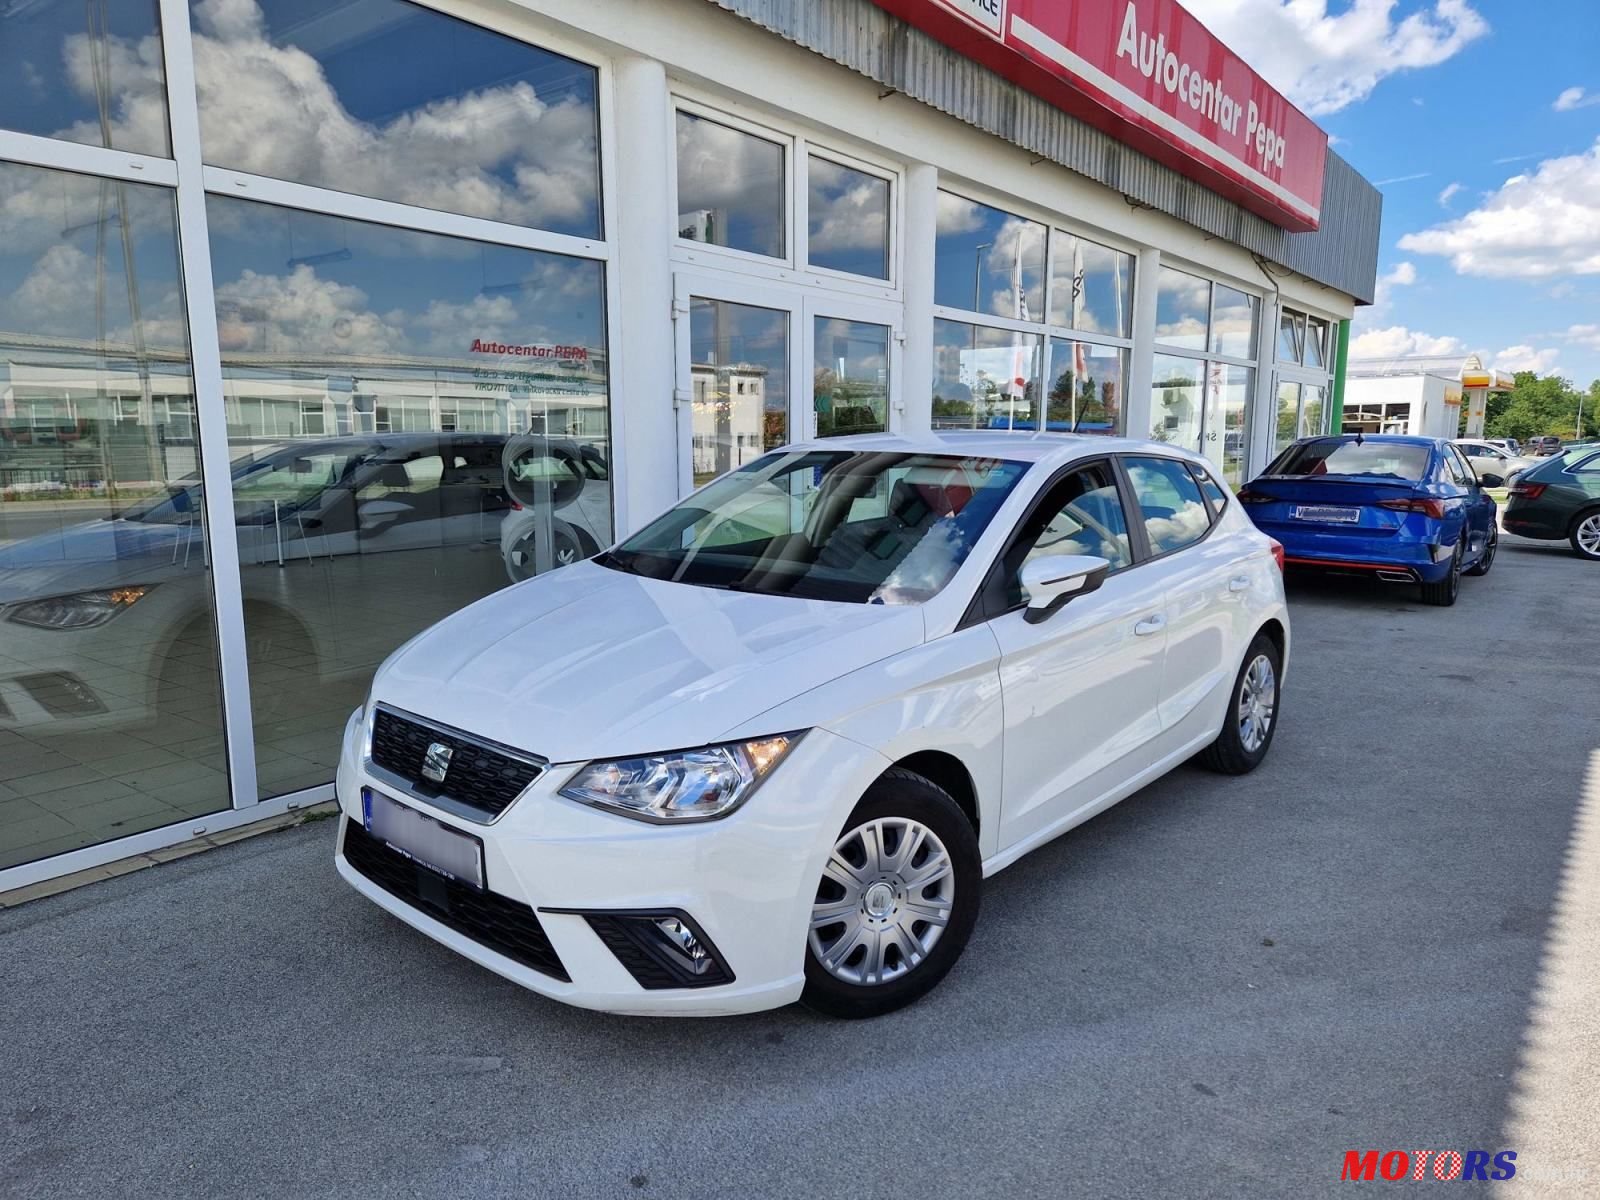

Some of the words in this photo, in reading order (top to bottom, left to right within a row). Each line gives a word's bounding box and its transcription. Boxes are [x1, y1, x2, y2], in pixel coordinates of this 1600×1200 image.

[1116, 1, 1242, 136] Autocentar
[1245, 100, 1286, 172] Pepa
[470, 338, 553, 358] Autocentar
[554, 345, 588, 360] PEPA
